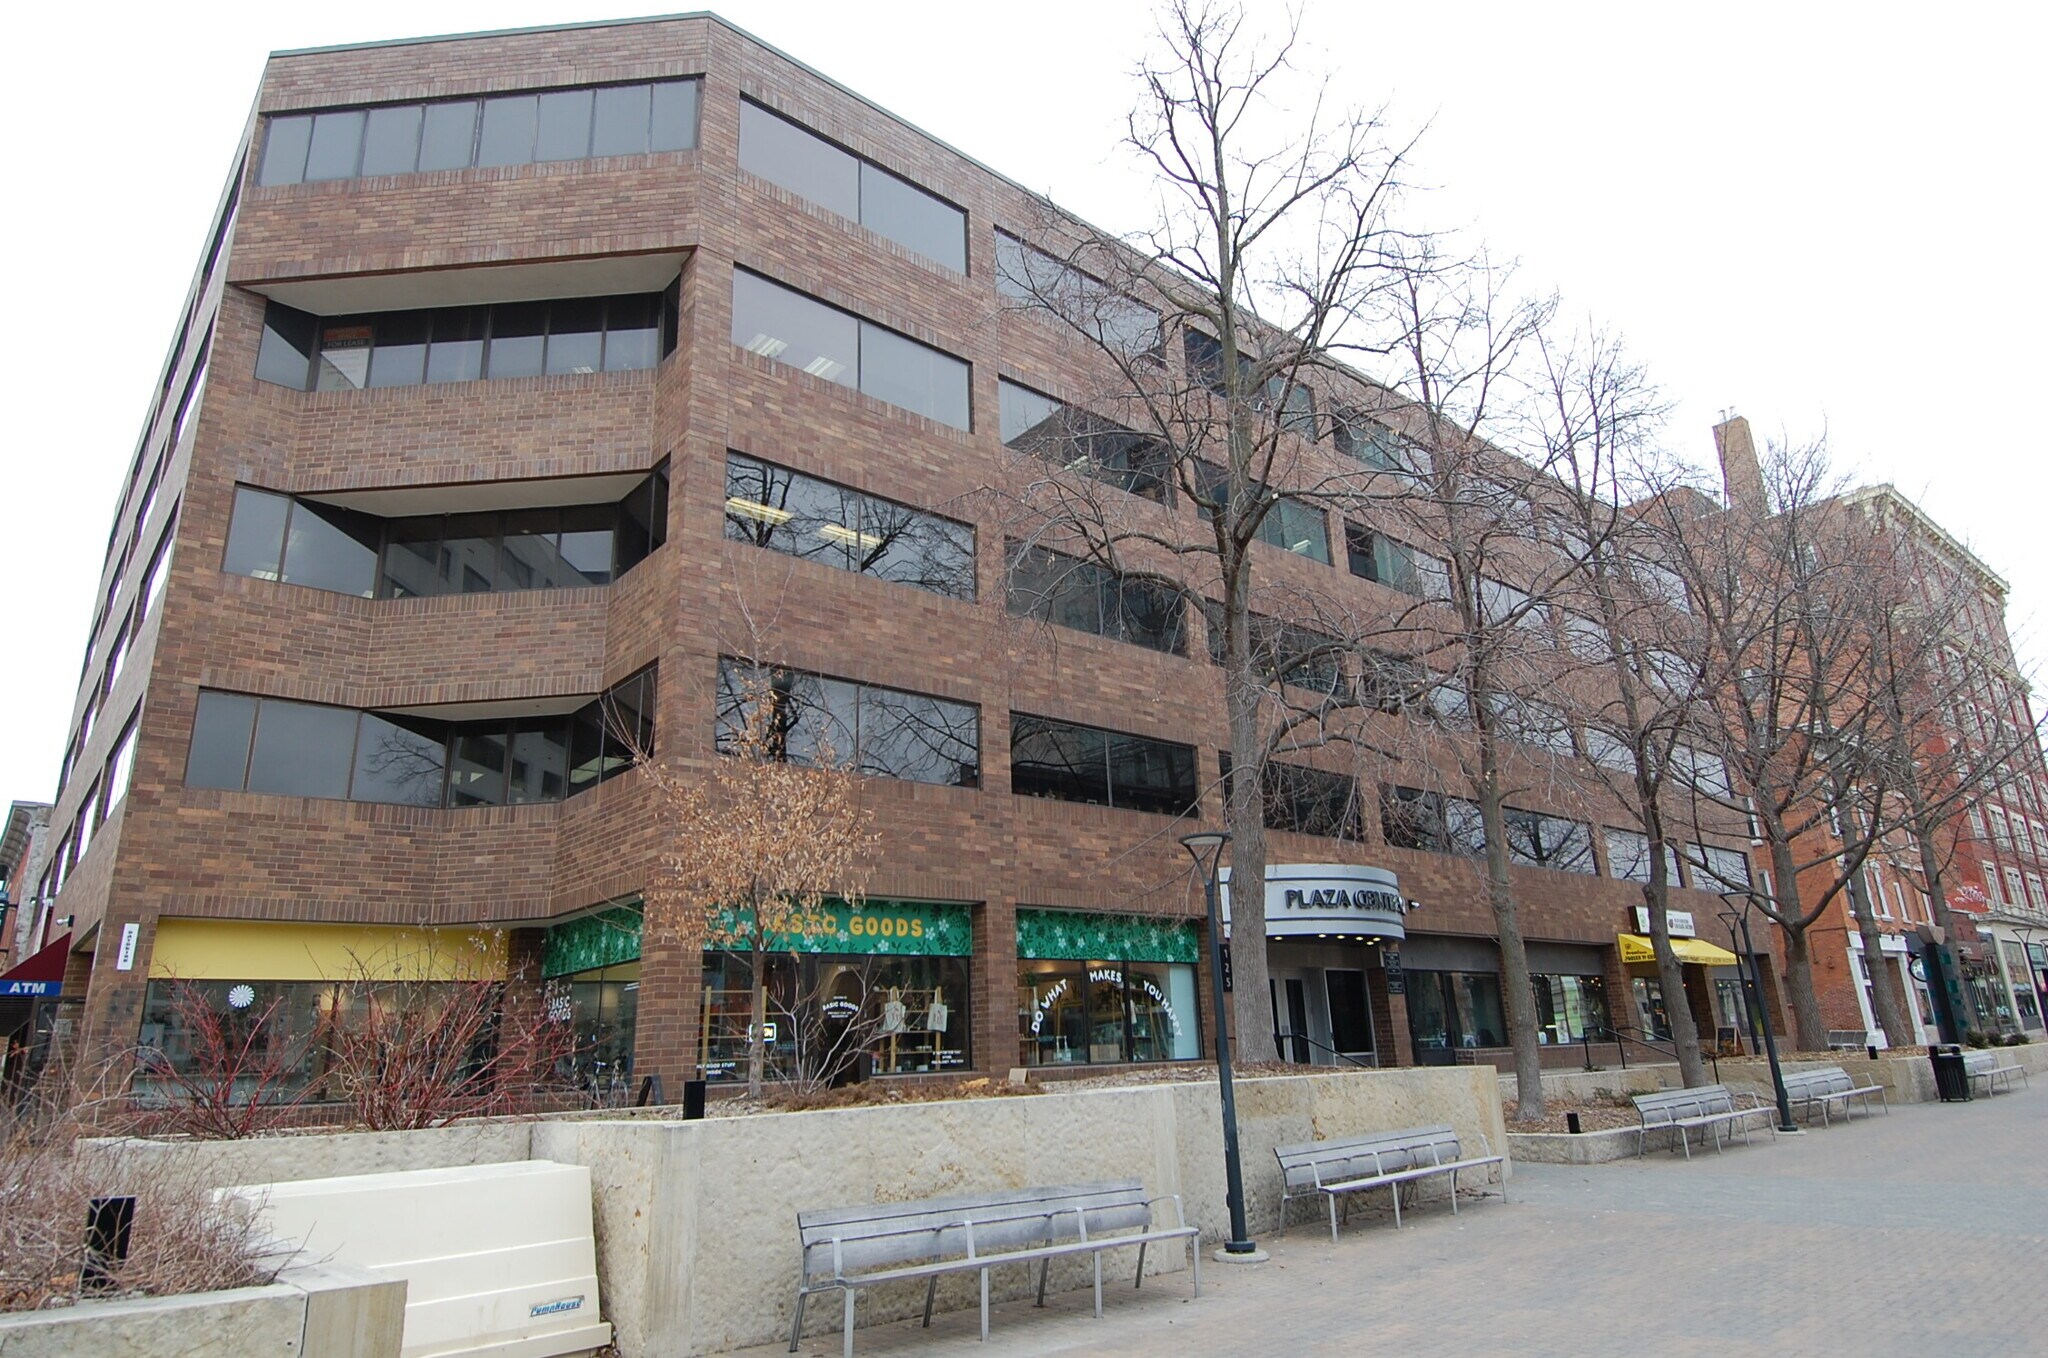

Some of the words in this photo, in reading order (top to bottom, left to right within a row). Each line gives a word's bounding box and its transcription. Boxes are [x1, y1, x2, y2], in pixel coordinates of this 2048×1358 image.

[1284, 889, 1352, 909] PLAZA
[849, 916, 923, 937] GOODS
[9, 982, 46, 994] ATM
[1031, 1010, 1044, 1034] DO
[1040, 978, 1069, 1009] WHAT
[1089, 969, 1122, 983] MAKES
[1143, 980, 1163, 1001] YOU
[1161, 998, 1183, 1037] HAPPY
